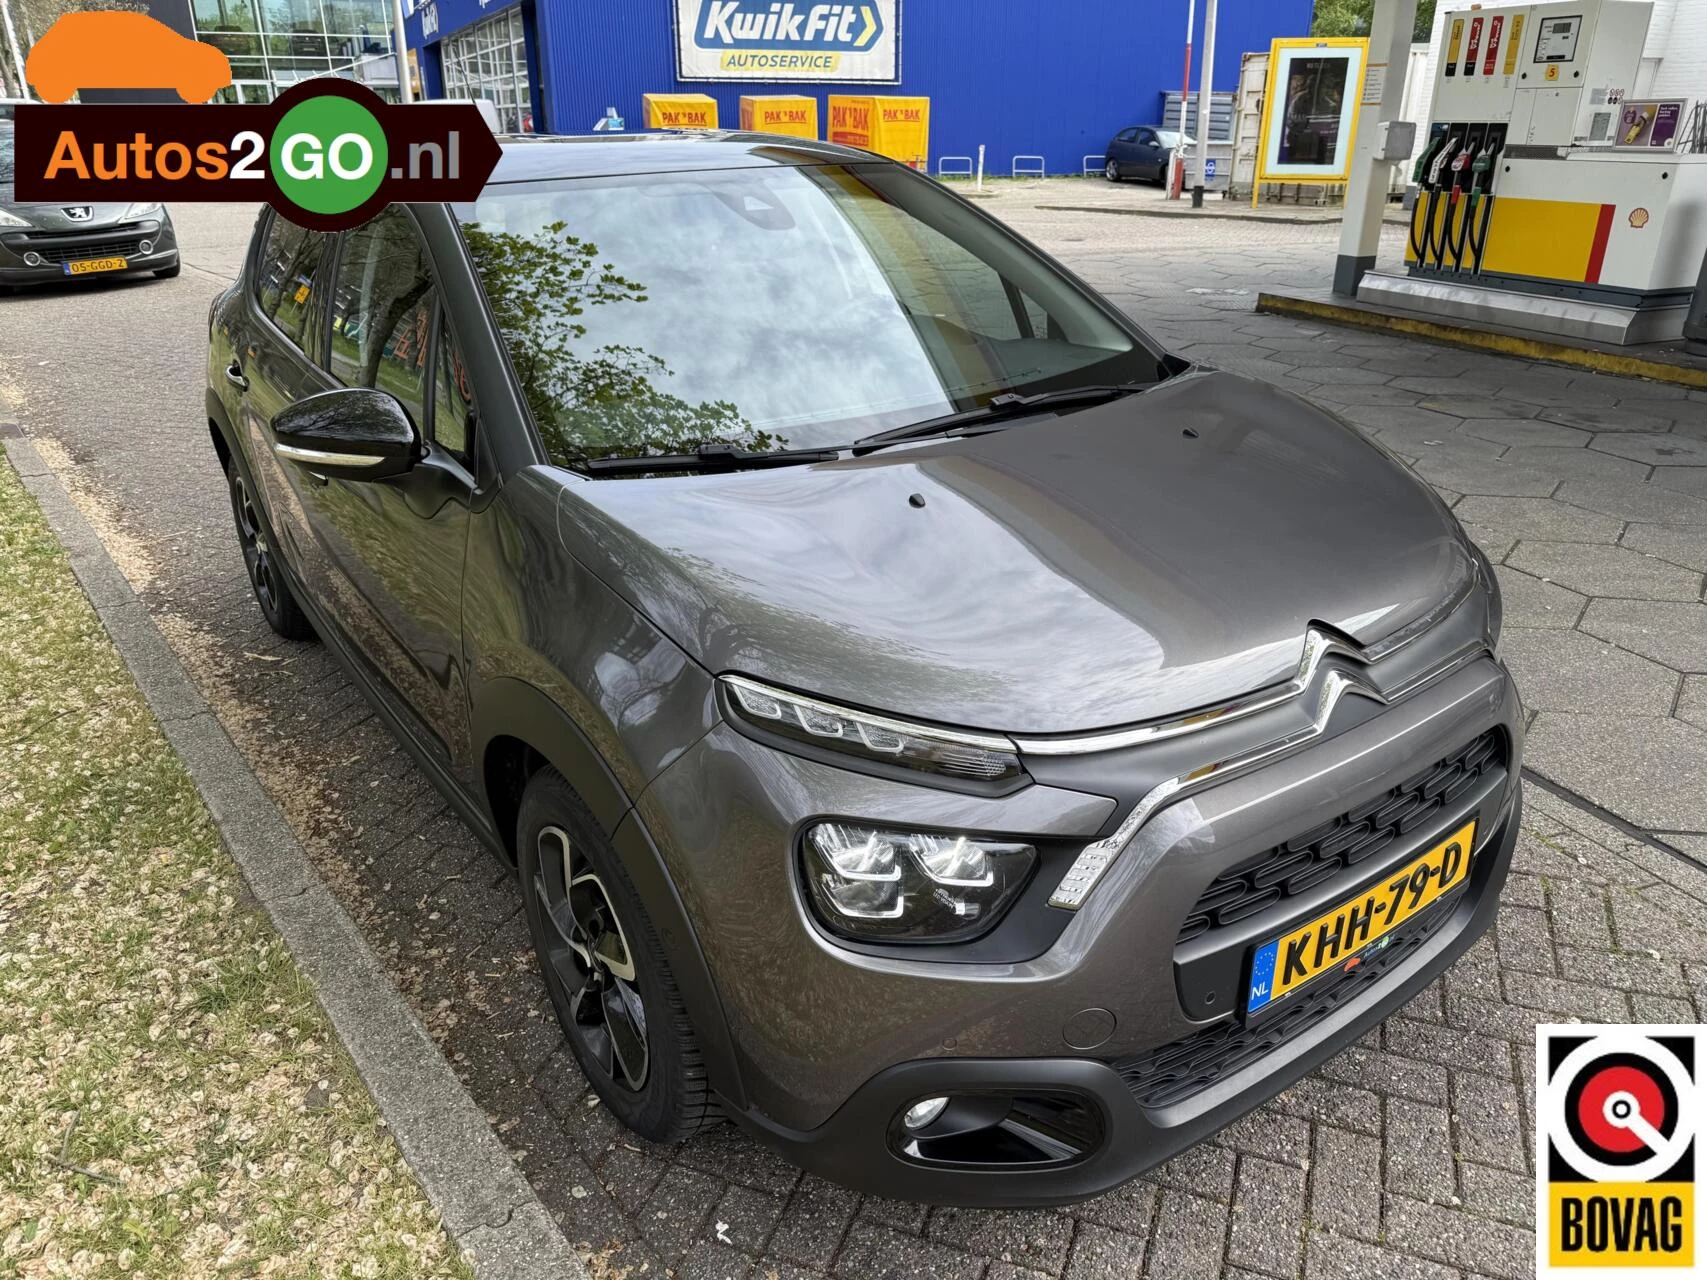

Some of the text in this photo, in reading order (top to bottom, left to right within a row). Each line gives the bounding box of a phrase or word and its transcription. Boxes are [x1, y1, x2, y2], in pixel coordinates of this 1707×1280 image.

[727, 54, 833, 69] AUTOSERVICE
[1548, 67, 1556, 78] 5
[662, 111, 680, 124] PAK
[688, 111, 707, 124] BAK
[764, 110, 781, 122] PAK
[789, 110, 806, 121] BAK
[832, 105, 847, 128] PAK
[853, 107, 870, 131] BAK
[883, 109, 898, 120] PAK
[904, 109, 920, 120] BAK
[1282, 841, 1462, 986] KHH-79-D
[1251, 981, 1269, 1000] NL
